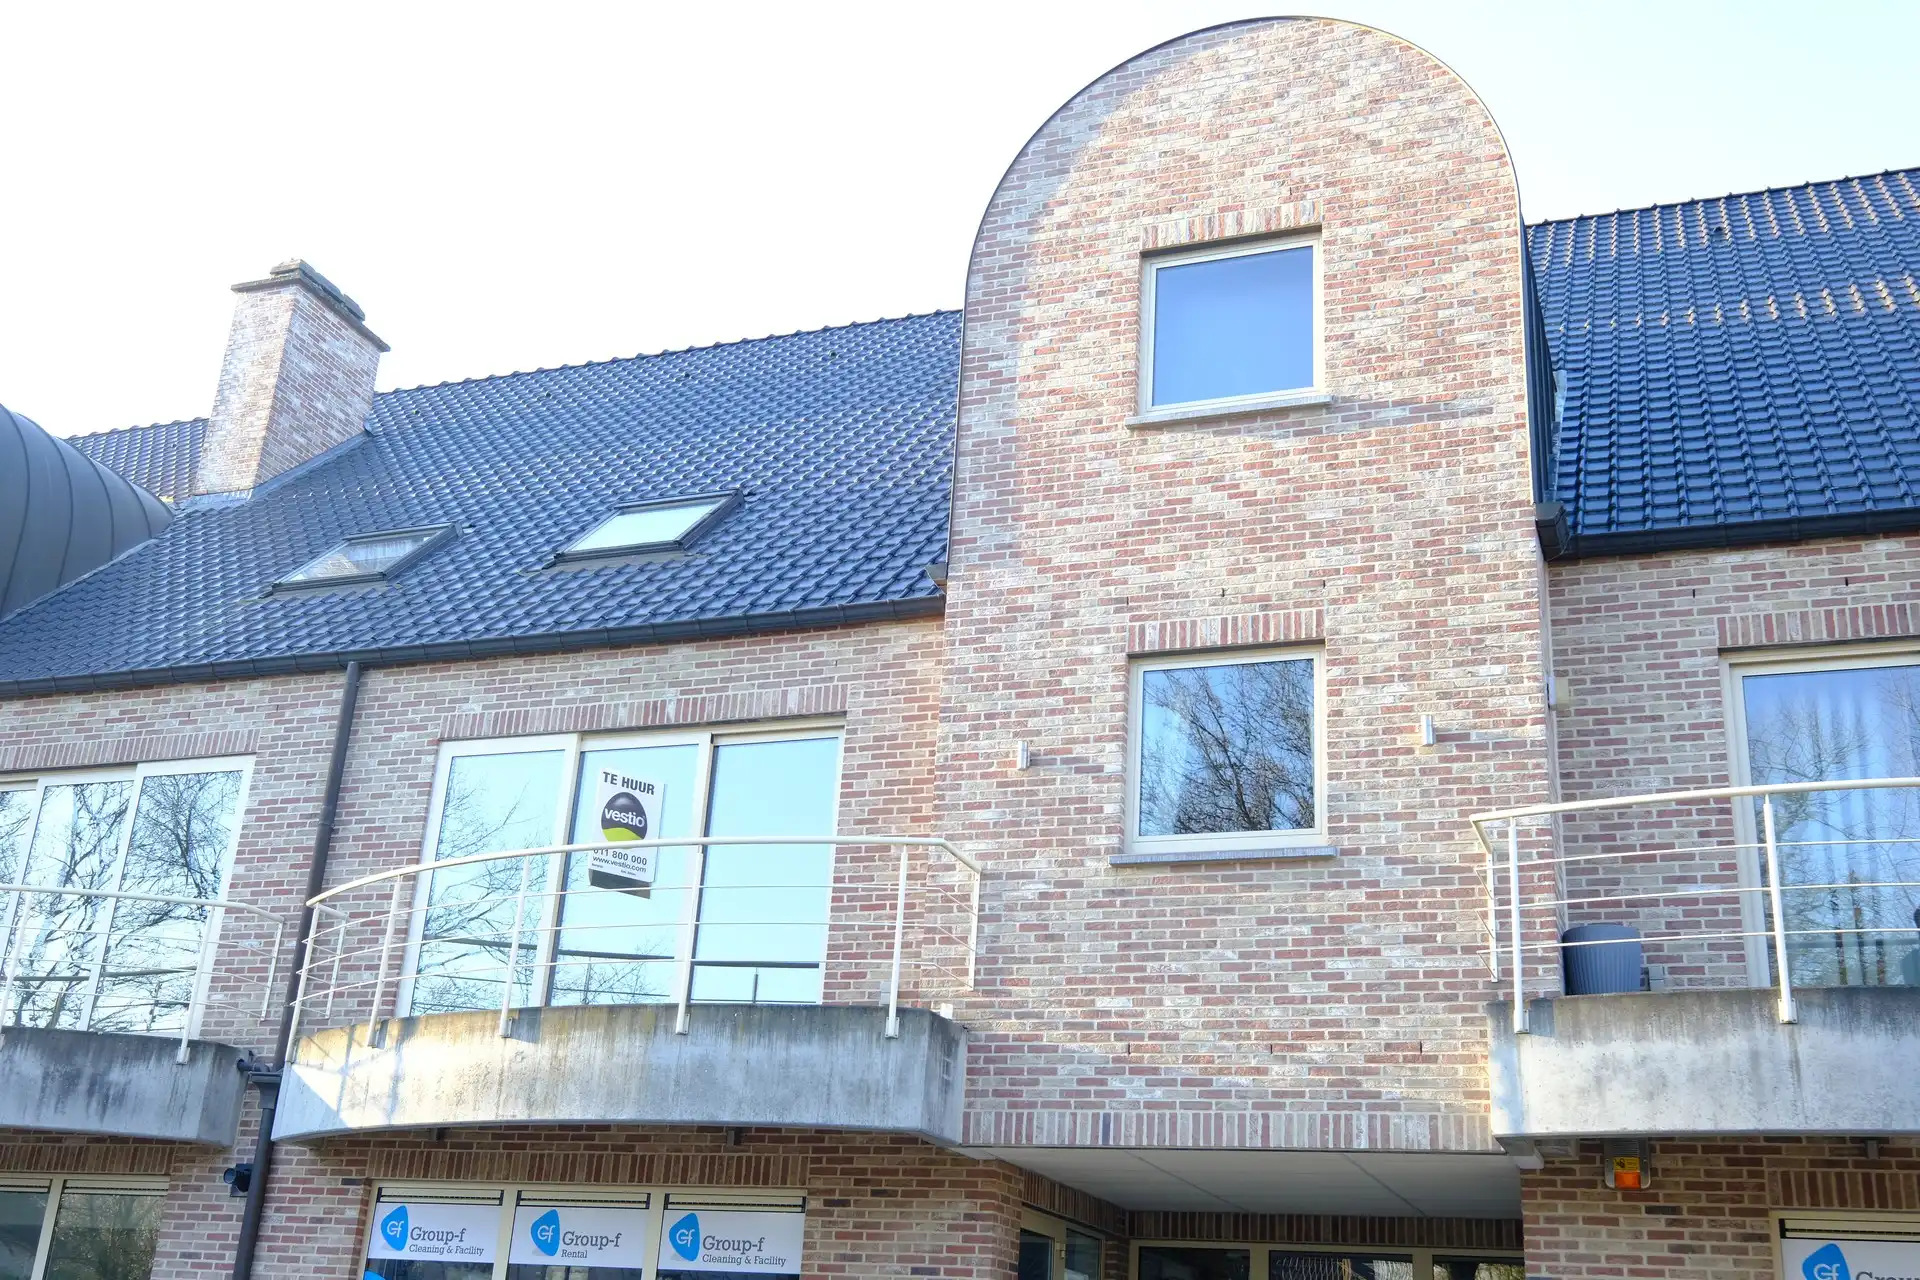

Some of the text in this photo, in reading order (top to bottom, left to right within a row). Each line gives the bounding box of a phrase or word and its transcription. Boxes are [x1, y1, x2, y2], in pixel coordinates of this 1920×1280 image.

[603, 771, 655, 795] TE HUUR
[604, 807, 645, 827] vestio
[592, 856, 647, 873] www.vestio.com
[612, 850, 629, 861] 800
[631, 855, 648, 866] 000
[410, 1226, 467, 1245] Group-f
[562, 1230, 623, 1250] Group-f
[409, 1244, 485, 1257] Cleaning & Facility
[561, 1249, 588, 1259] Rental
[702, 1235, 766, 1255] Group-f
[702, 1254, 787, 1268] Cleaning & Facility
